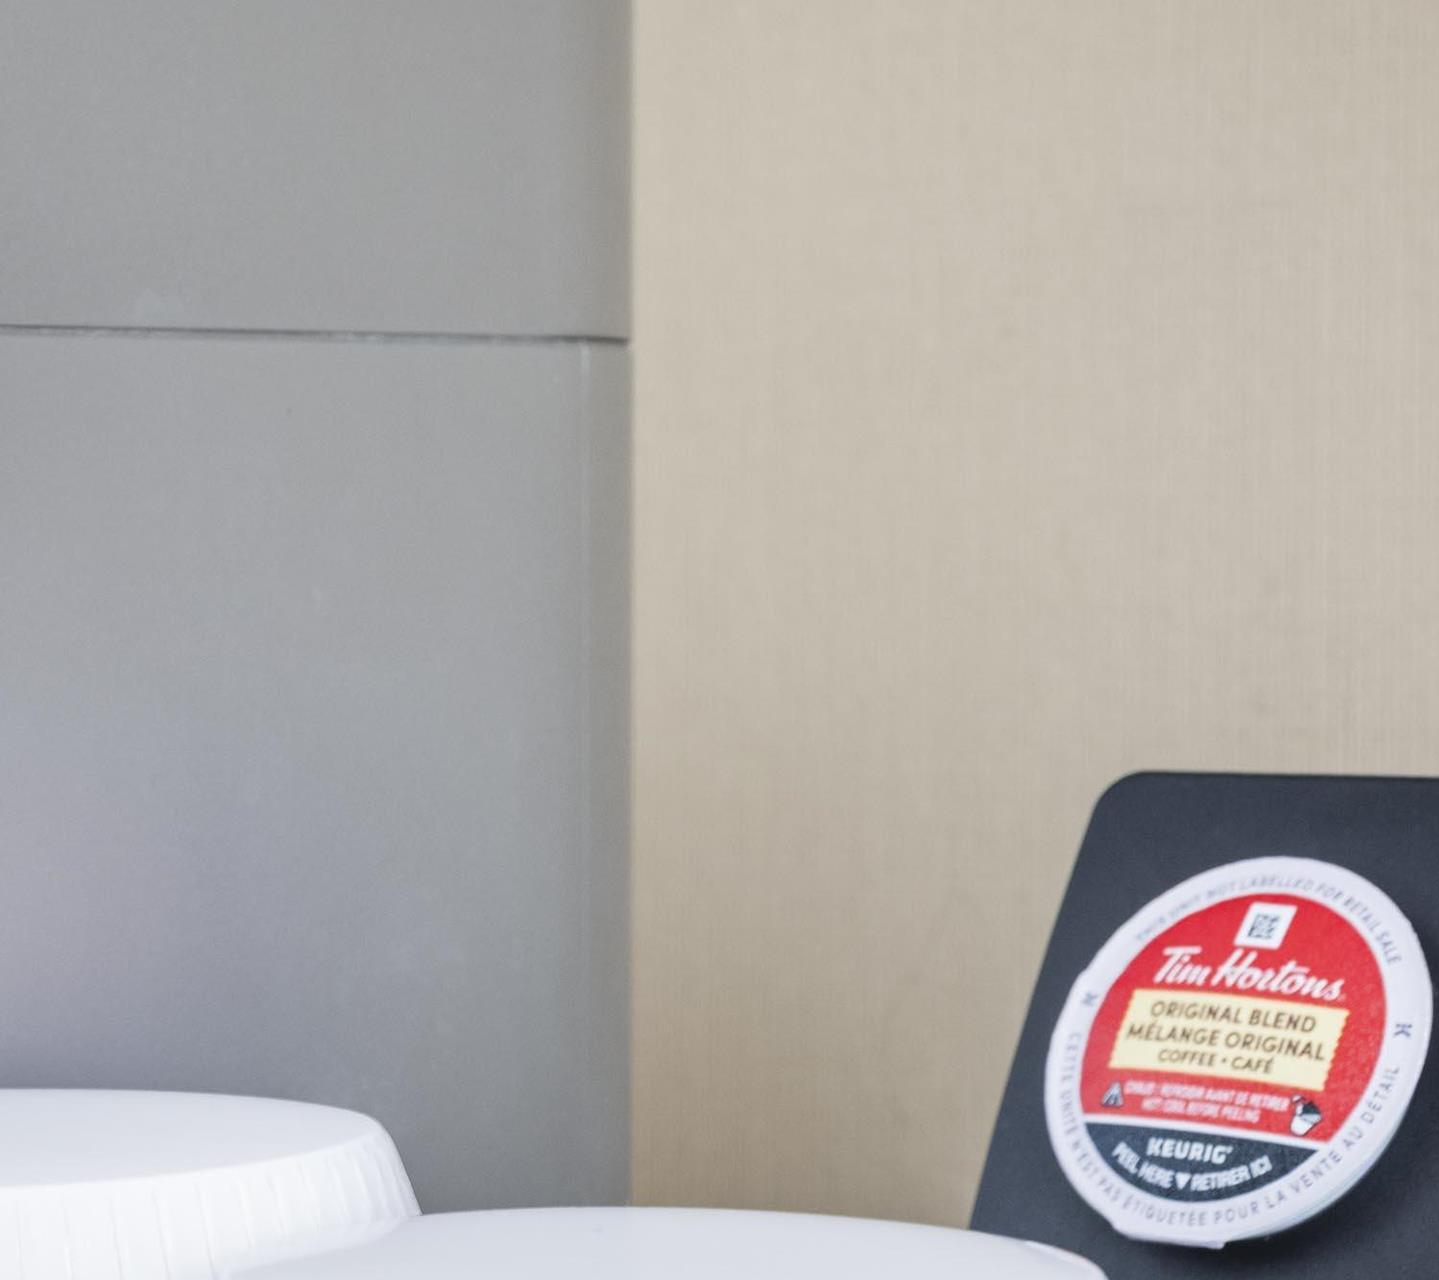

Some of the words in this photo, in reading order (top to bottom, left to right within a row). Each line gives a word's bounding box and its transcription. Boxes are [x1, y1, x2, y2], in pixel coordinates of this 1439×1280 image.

[1153, 945, 1212, 987] Tim
[1211, 947, 1345, 1001] Hortons
[1150, 1000, 1243, 1025] ORIGINAL
[1248, 1008, 1317, 1034] BLEND
[1126, 1022, 1221, 1047] MÉLANGE
[1224, 1031, 1326, 1062] ORIGINAL
[1157, 1048, 1216, 1068] COFFEE
[1231, 1056, 1275, 1075] CAFÉ
[1214, 1201, 1261, 1225] POUR
[1265, 1190, 1287, 1210] LA
[1289, 1150, 1344, 1195] VENTE
[1342, 1126, 1365, 1149] AU
[1360, 1064, 1400, 1125] DÉTAIL
